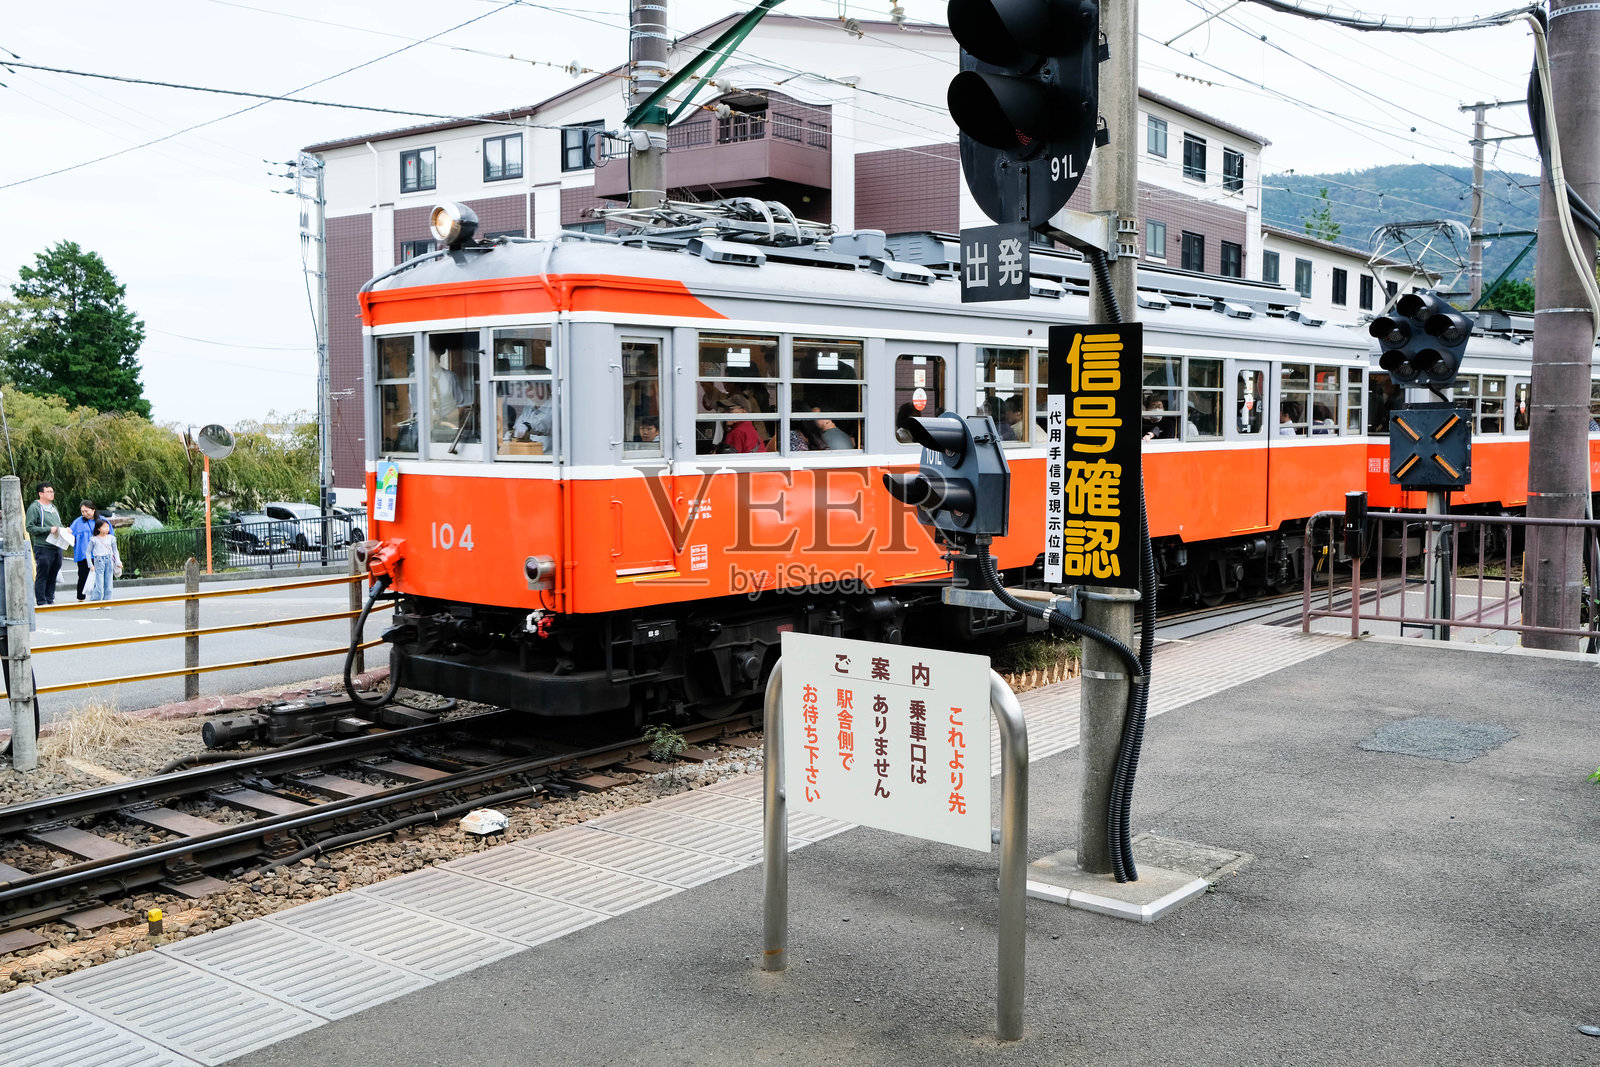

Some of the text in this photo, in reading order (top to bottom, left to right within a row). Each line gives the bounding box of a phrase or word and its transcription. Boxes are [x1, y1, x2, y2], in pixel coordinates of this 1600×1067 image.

[1051, 154, 1078, 182] 91L
[966, 238, 1023, 289] 出発
[1048, 410, 1062, 567] 代用手信号現示位置
[1065, 333, 1123, 579] 信号確認
[432, 521, 474, 552] 104
[834, 653, 930, 687] ご案内
[802, 683, 821, 803] お待ち下さい
[836, 688, 855, 771] 駅舎側で
[872, 693, 891, 799] ありません
[909, 699, 928, 785] 乗車口は
[947, 706, 967, 815] これより先
